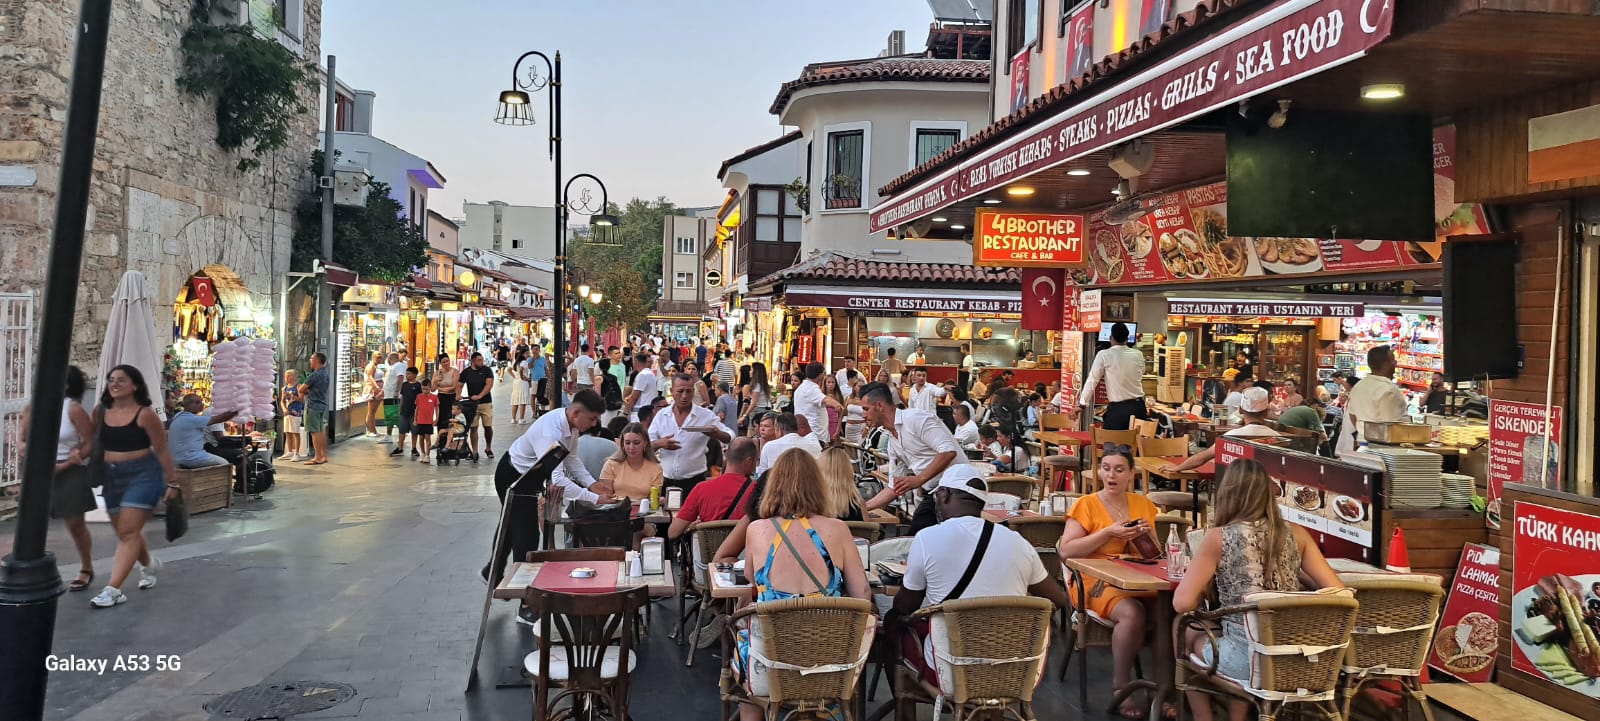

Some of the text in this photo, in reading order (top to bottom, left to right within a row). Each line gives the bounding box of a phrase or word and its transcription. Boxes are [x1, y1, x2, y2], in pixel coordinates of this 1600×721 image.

[1019, 135, 1052, 167] KEBAPS
[1059, 115, 1097, 152] STEAKS
[1106, 92, 1152, 134] PIZZAS
[1161, 61, 1221, 110] GRILLS
[1235, 39, 1275, 85] SEA
[1280, 9, 1344, 66] FOOD
[1187, 186, 1215, 204] PASTAS
[983, 234, 1080, 252] RESTAURANT
[1010, 251, 1029, 259] CAFE
[1039, 252, 1054, 260] BAR
[848, 297, 890, 308] CENTER
[895, 300, 965, 311] RESTAURANT
[968, 301, 1000, 311] KEBAB
[1170, 303, 1232, 314] RESTAURANT
[1273, 305, 1323, 315] USTANIN
[1494, 403, 1519, 416] GERÇEK
[1517, 514, 1558, 543] TÜRK
[1456, 582, 1475, 596] PIZZA
